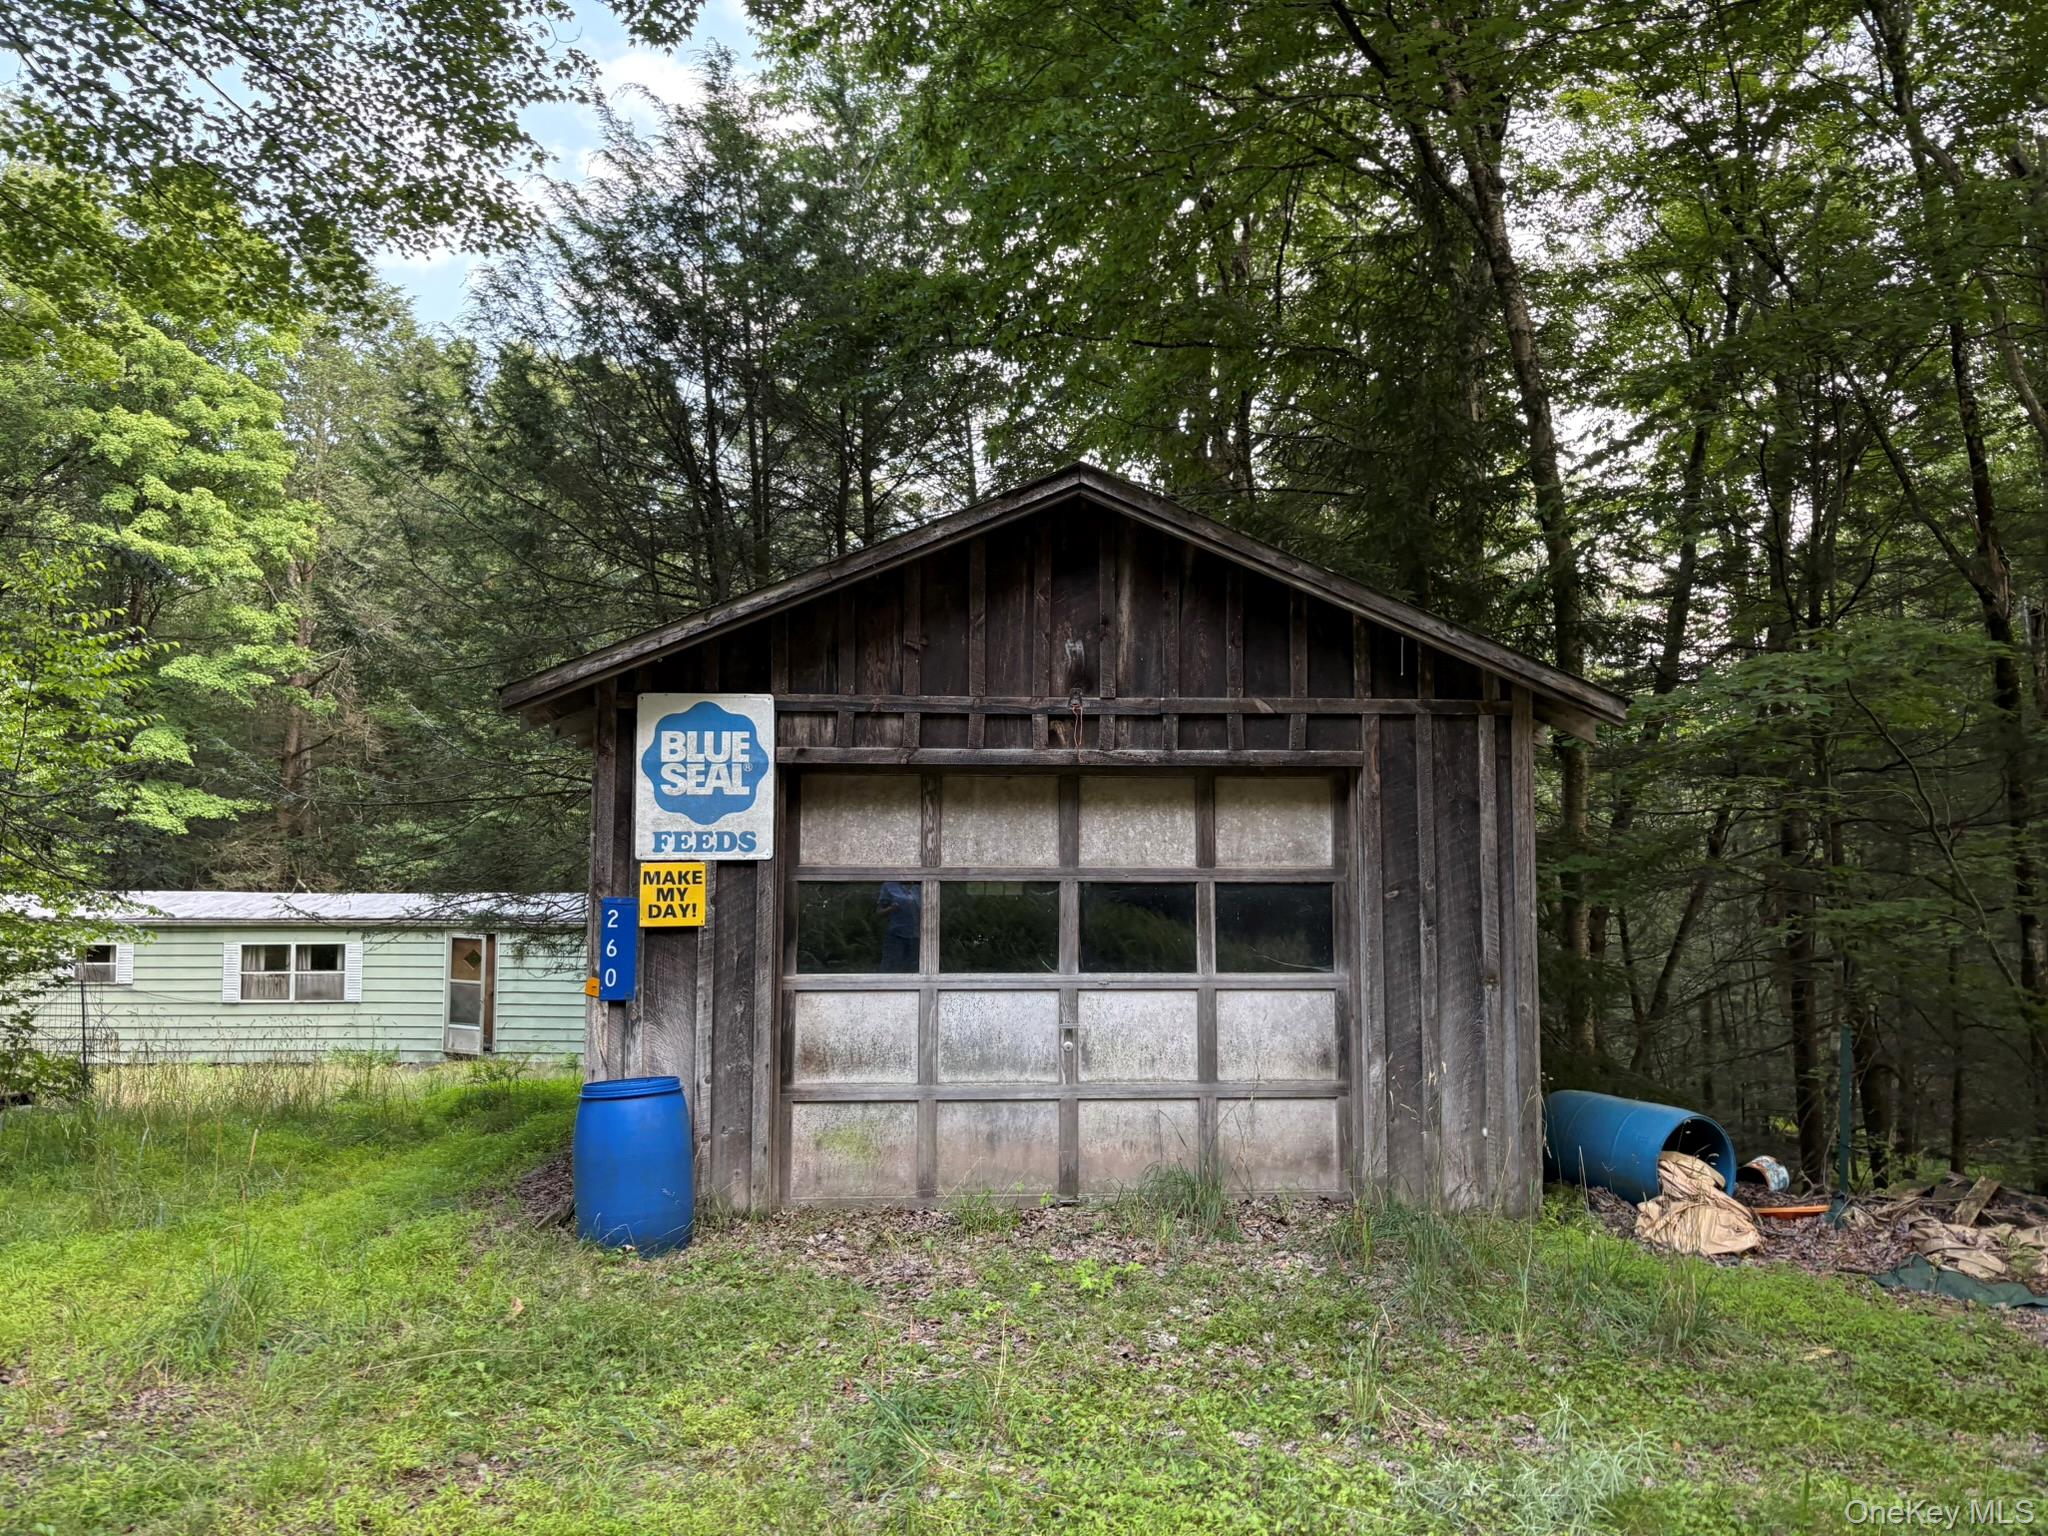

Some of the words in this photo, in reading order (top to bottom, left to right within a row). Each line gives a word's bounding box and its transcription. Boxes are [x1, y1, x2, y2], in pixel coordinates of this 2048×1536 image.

[660, 731, 750, 763] BLUE
[652, 831, 757, 853] FEEDS
[643, 871, 703, 885] MAKE
[656, 888, 688, 902] MY
[648, 904, 697, 919] DAY!
